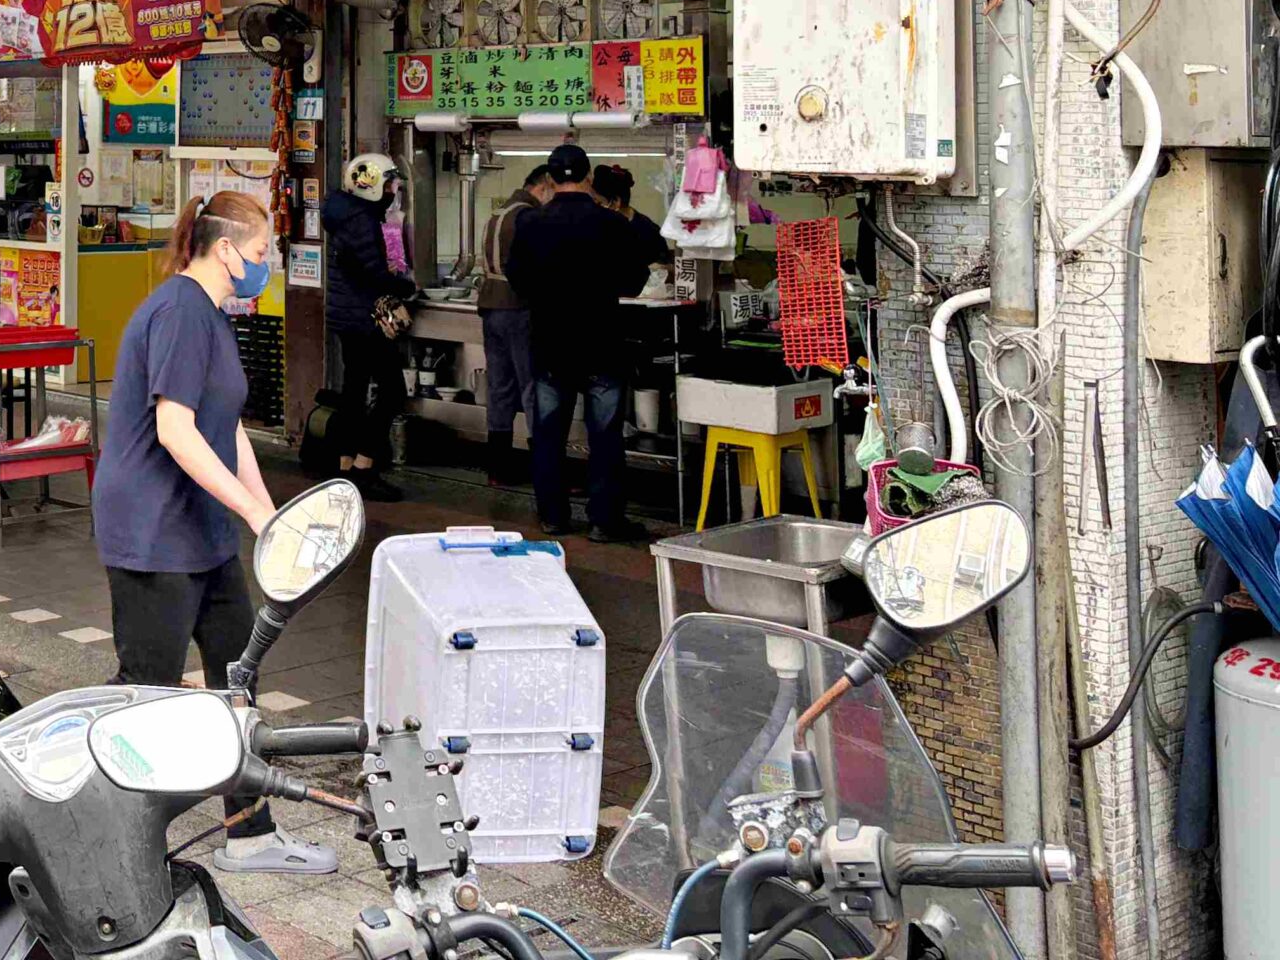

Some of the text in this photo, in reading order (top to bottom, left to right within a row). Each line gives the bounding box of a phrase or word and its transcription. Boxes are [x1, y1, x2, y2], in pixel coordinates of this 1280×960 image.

[438, 53, 457, 108] 豆芽菜 35
[461, 96, 479, 107] 15
[485, 51, 507, 107] 炒米粉 35
[514, 95, 534, 107] 35
[538, 47, 560, 106] 清湯 20
[564, 94, 585, 106] 55
[595, 48, 612, 112] 公休
[658, 48, 675, 106] 請排隊
[676, 47, 698, 106] 外帶區
[733, 293, 763, 319] 湯匙
